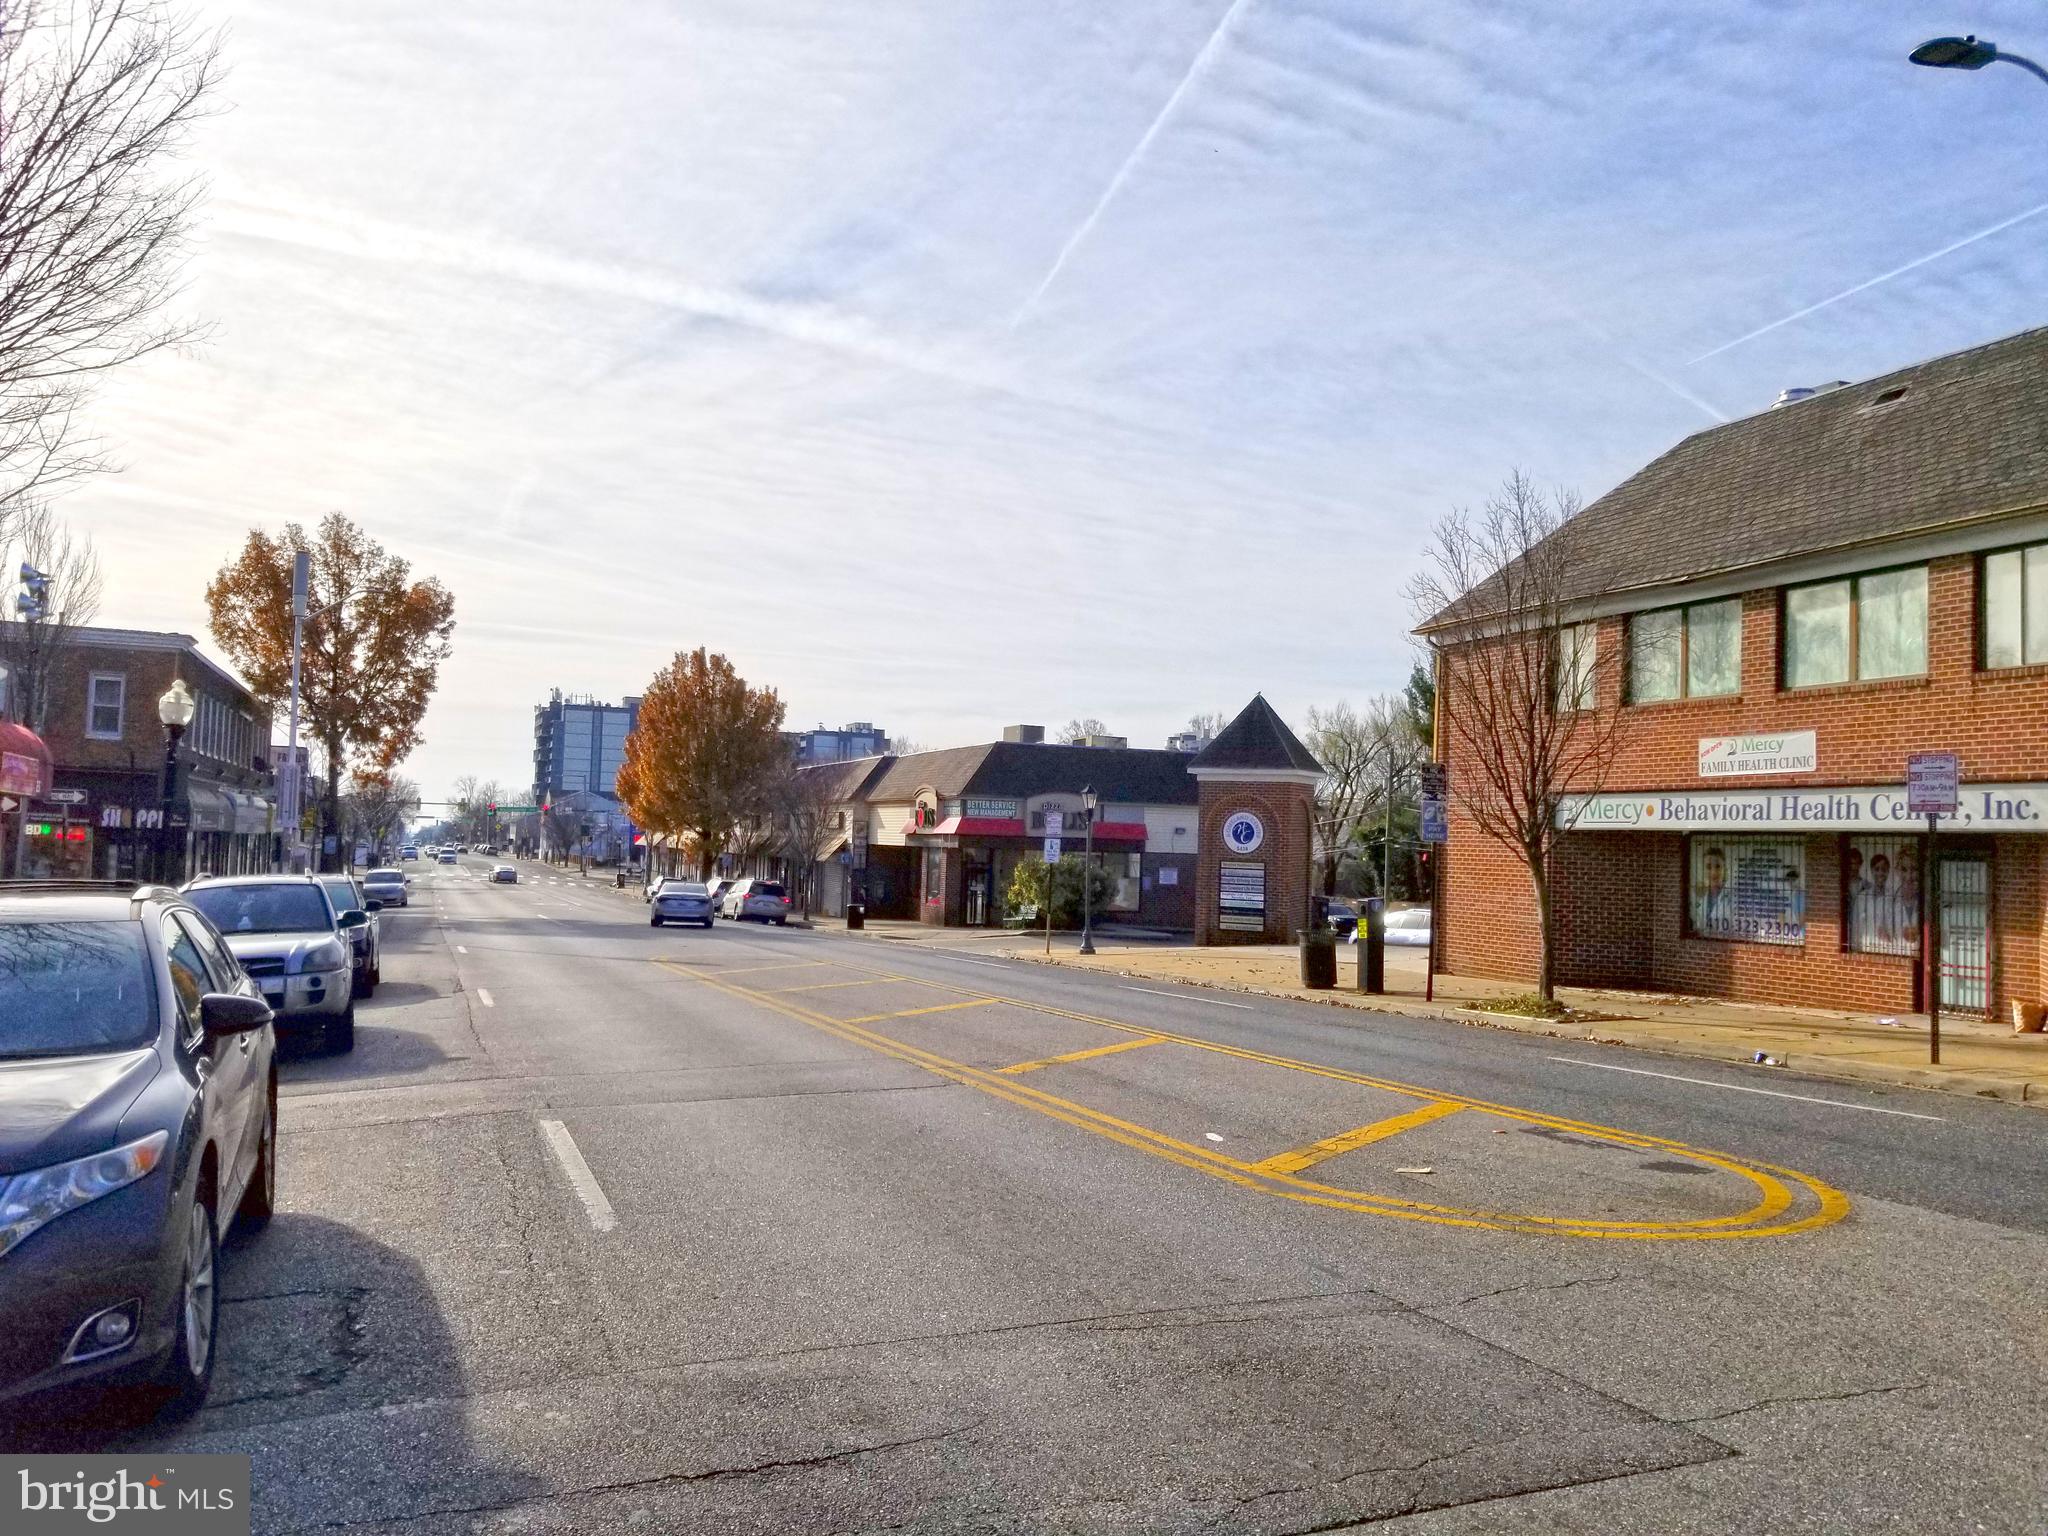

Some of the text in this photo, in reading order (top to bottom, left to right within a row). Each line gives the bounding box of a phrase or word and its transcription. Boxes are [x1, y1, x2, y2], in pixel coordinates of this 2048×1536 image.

[1742, 738, 1784, 754] Mercy
[1701, 755, 1814, 773] FAMILY HEALTH CLINIC
[967, 800, 990, 809] BETTER
[991, 801, 1016, 809] SERVICE
[1583, 791, 2040, 826] Mercy Behavioral Health Cer, Inc.
[980, 809, 1016, 817] MANAGEMENT
